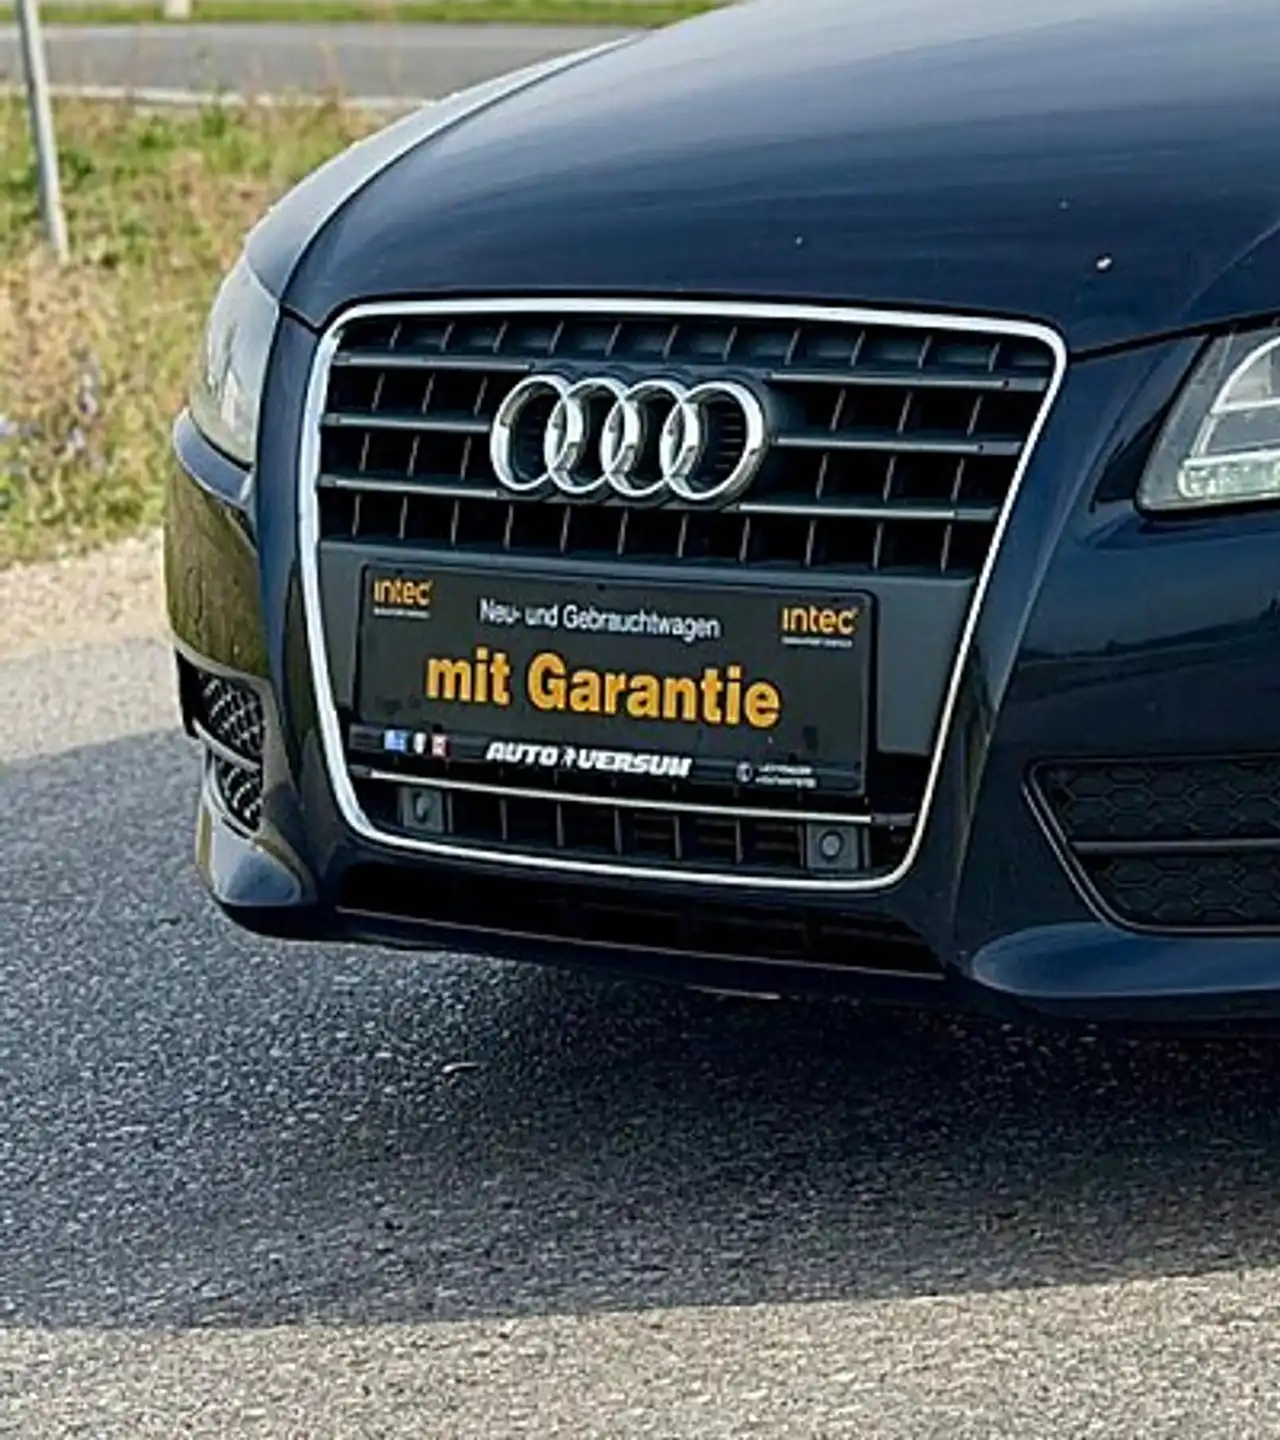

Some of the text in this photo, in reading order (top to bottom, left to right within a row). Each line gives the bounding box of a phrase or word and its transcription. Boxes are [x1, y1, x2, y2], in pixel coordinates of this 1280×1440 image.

[372, 578, 432, 606] intec
[479, 596, 721, 643] Neu- und Gebrauchtwagen
[780, 605, 859, 635] intec
[426, 647, 781, 728] mit Garantie
[485, 741, 559, 767] AUTO
